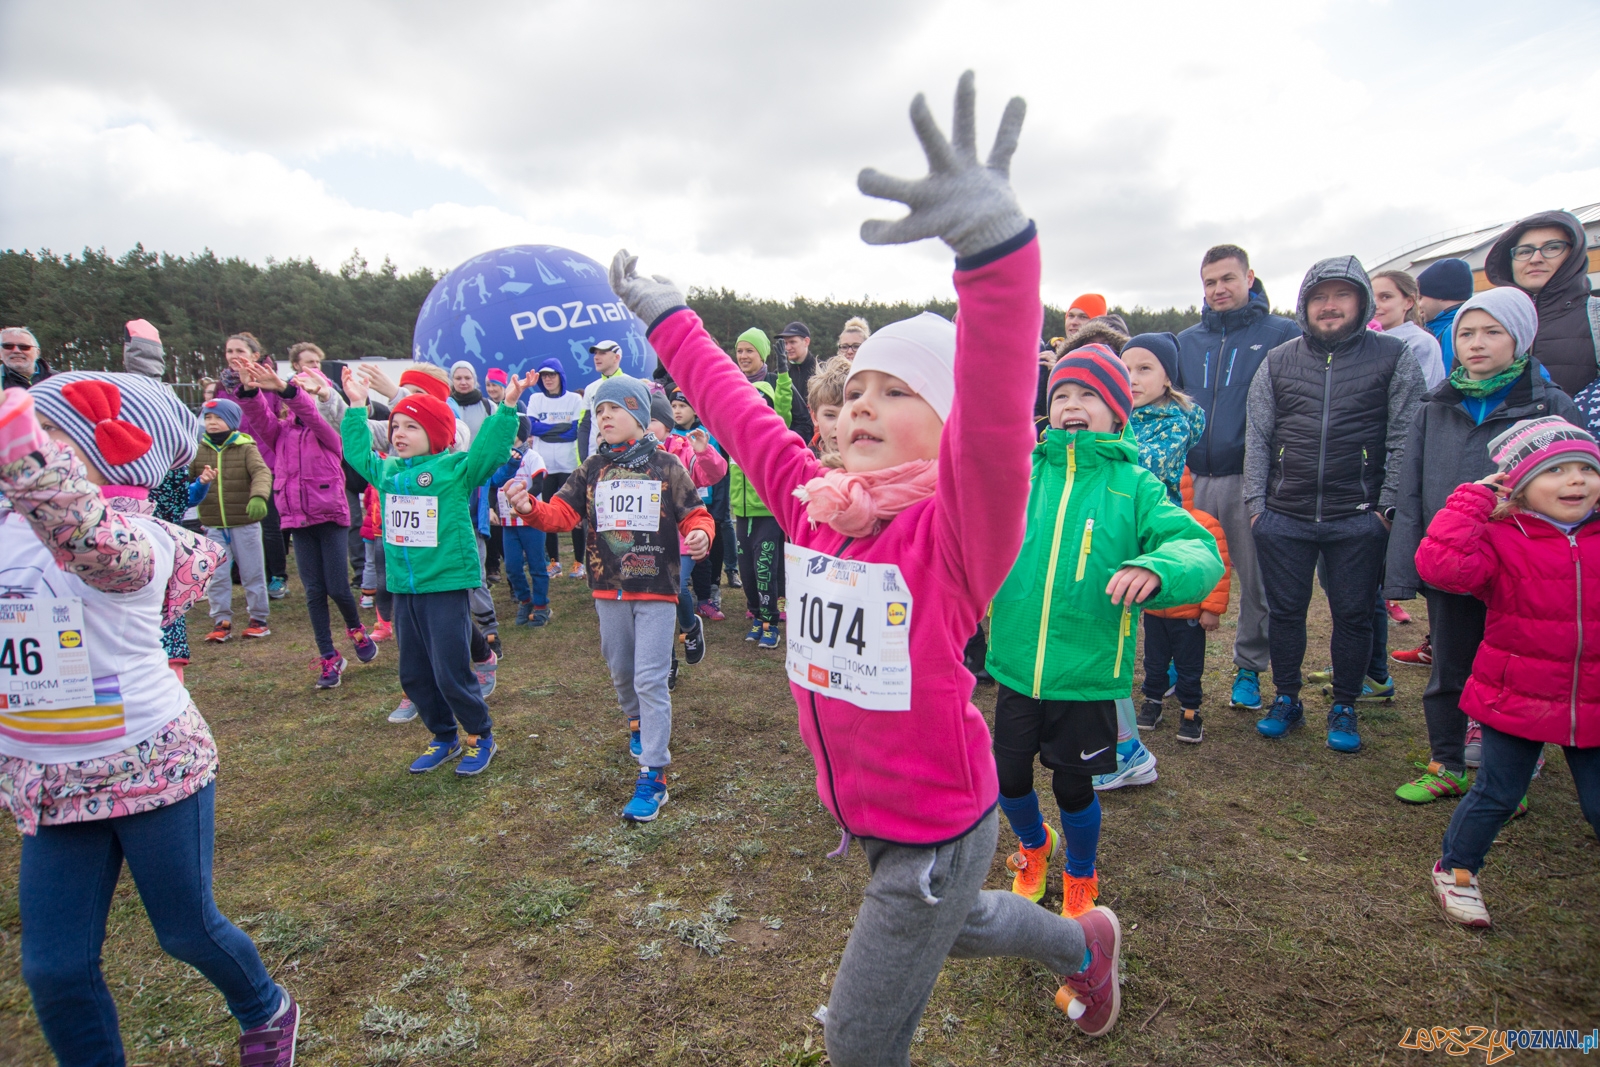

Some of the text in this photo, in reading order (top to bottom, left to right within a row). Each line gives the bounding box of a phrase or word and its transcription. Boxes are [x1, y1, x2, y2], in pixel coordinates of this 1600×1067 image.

[609, 495, 643, 513] 1021
[391, 510, 420, 529] 1075
[757, 541, 775, 591] SKATE
[799, 592, 866, 657] 1074
[847, 660, 877, 677] 10KM
[24, 679, 58, 690] 10KM
